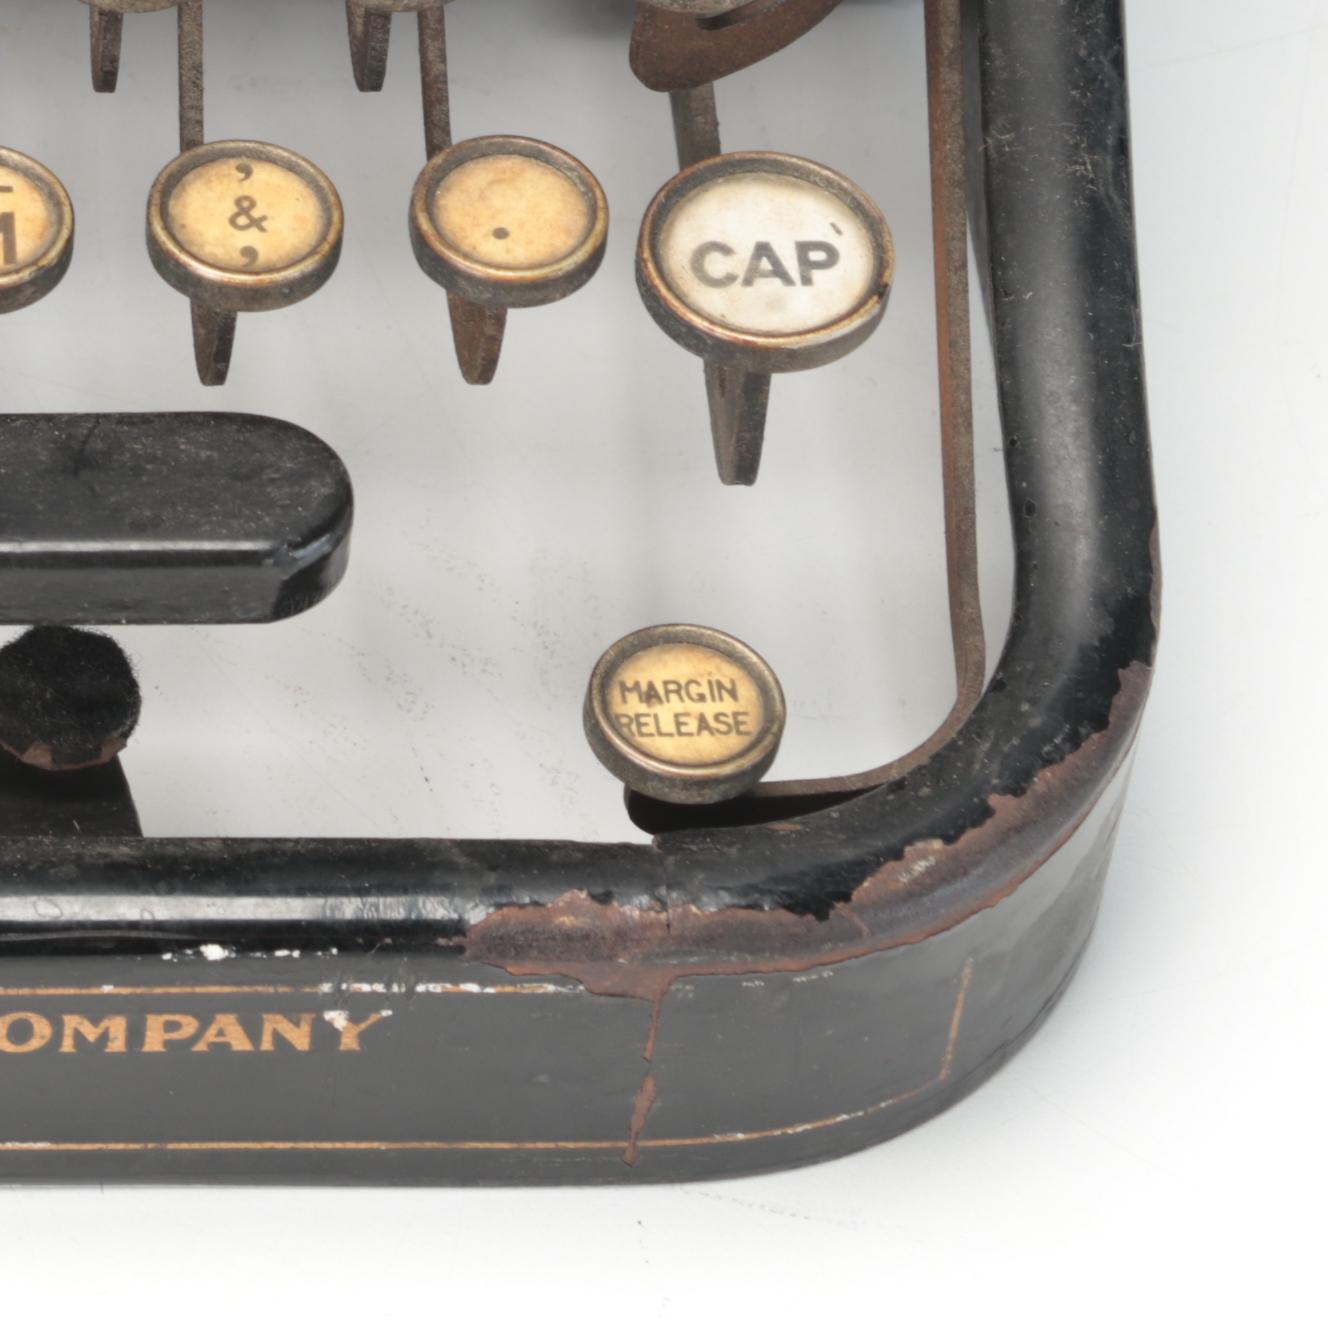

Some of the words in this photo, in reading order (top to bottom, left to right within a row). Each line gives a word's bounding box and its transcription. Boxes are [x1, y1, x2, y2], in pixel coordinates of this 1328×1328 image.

[228, 195, 268, 234] &
[689, 240, 840, 289] CAP
[619, 679, 739, 704] MARGIN
[617, 711, 752, 737] RELEASE
